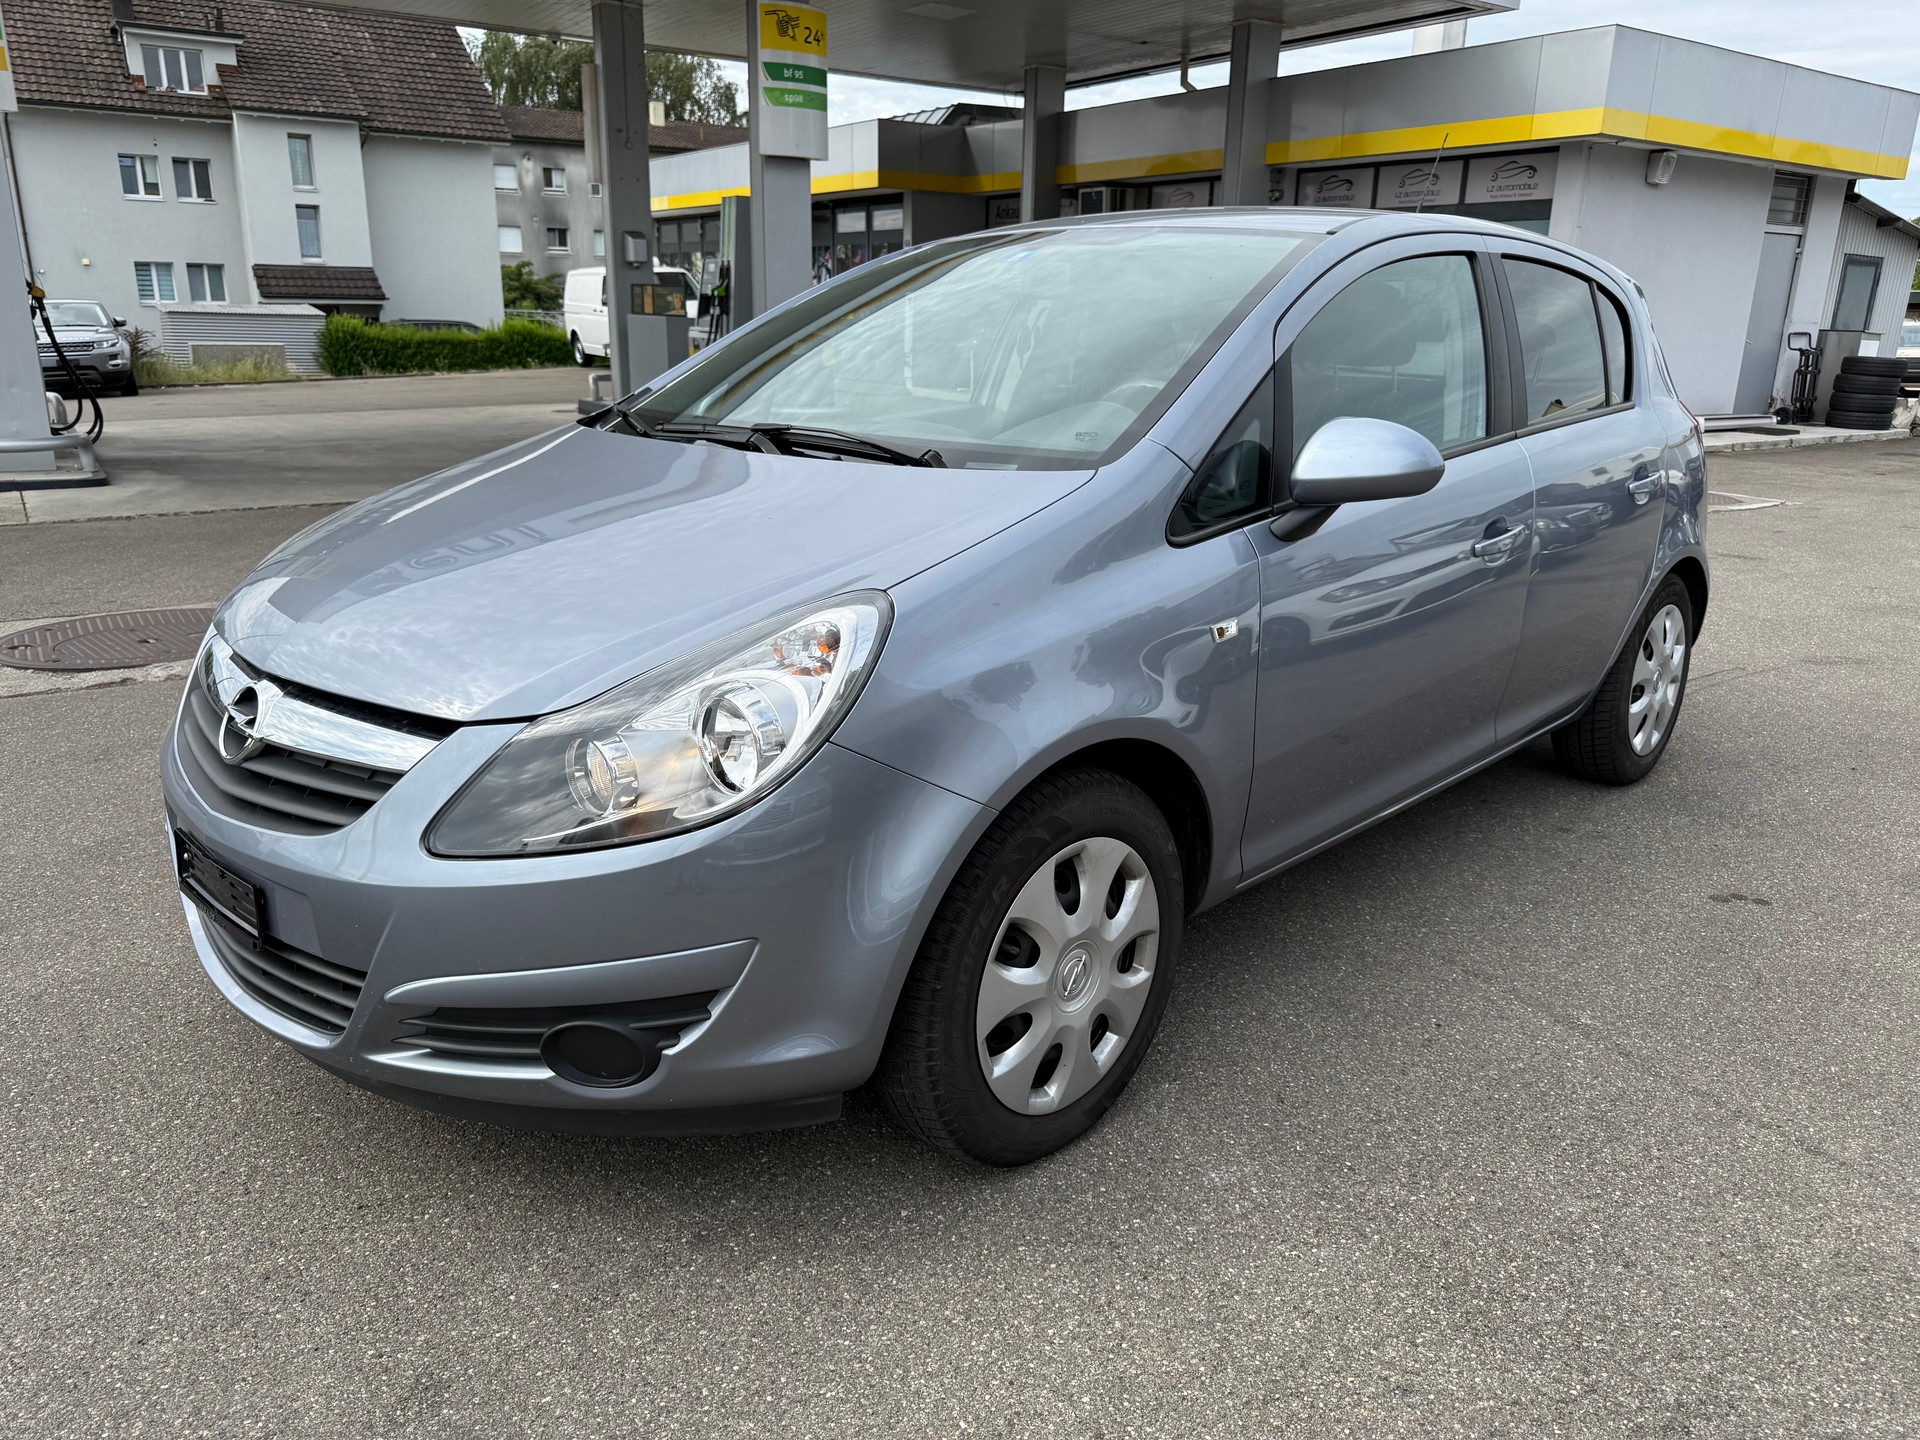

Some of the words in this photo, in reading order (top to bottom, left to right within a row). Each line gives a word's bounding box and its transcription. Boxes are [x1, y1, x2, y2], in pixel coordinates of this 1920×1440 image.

[783, 67, 793, 77] bf
[794, 69, 804, 79] 95
[783, 94, 804, 104] sp98
[994, 204, 1019, 220] Ankau
